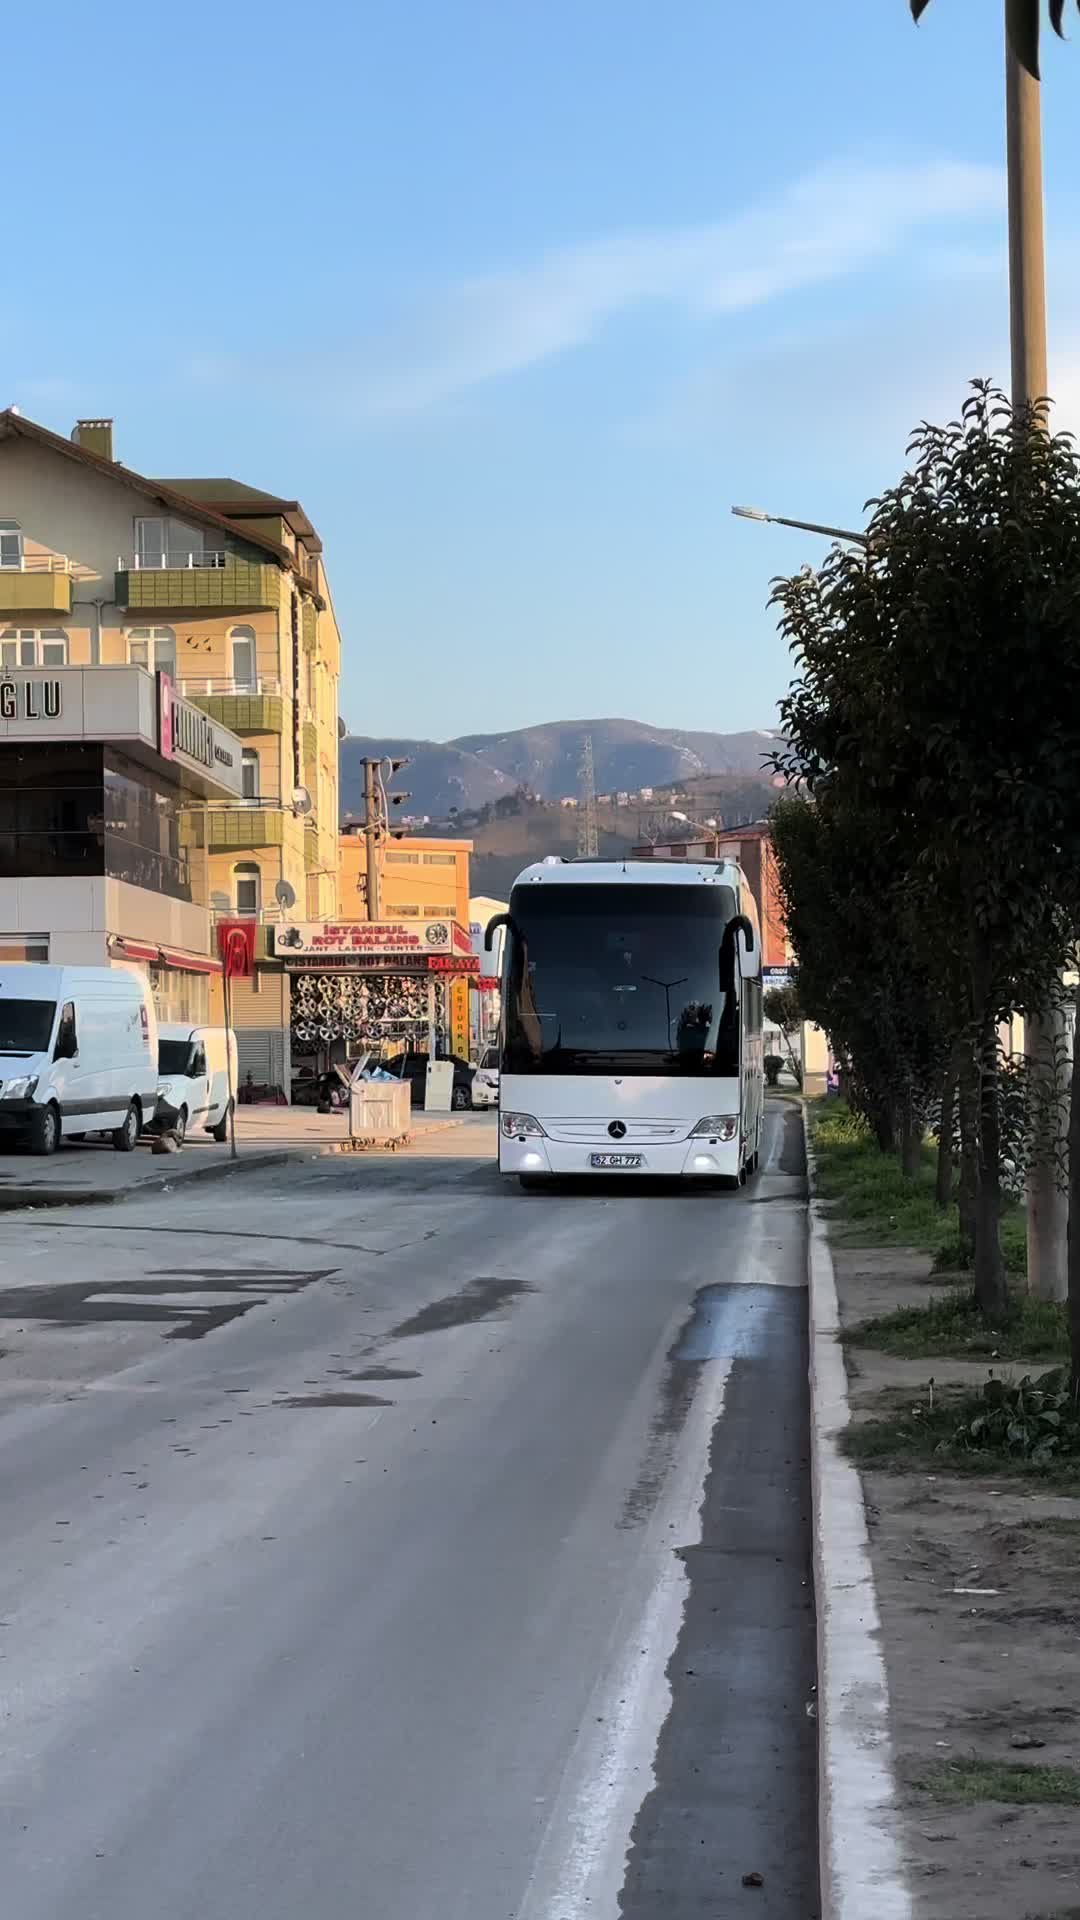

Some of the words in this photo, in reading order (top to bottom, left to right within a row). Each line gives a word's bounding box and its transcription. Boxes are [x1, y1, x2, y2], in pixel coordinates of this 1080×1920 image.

[323, 924, 408, 935] İSTANBUL
[312, 936, 346, 945] ROT
[351, 935, 420, 945] BALANS
[596, 1156, 606, 1165] 52
[609, 1156, 622, 1165] GH
[625, 1156, 641, 1165] 772
